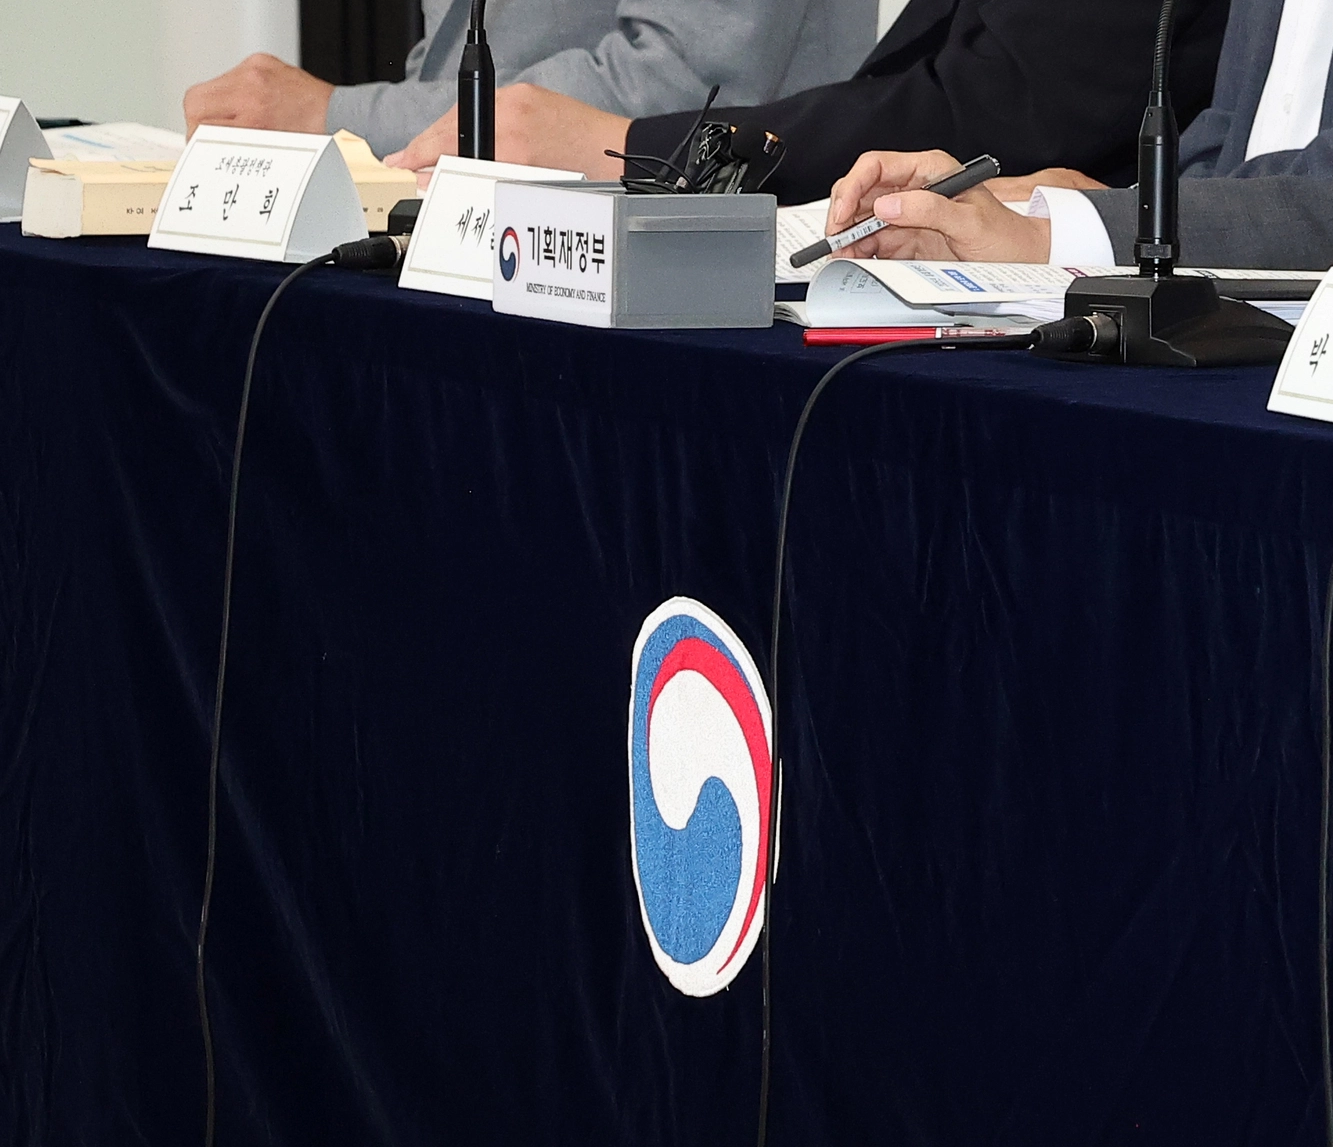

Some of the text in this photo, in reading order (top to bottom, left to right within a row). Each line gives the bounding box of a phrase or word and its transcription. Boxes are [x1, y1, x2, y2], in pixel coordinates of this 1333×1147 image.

[215, 156, 273, 177] 조세총괄정책관
[527, 226, 605, 274] 기획재정부
[526, 282, 606, 303] MINISTRY OF ECONOMY AND FINANCE
